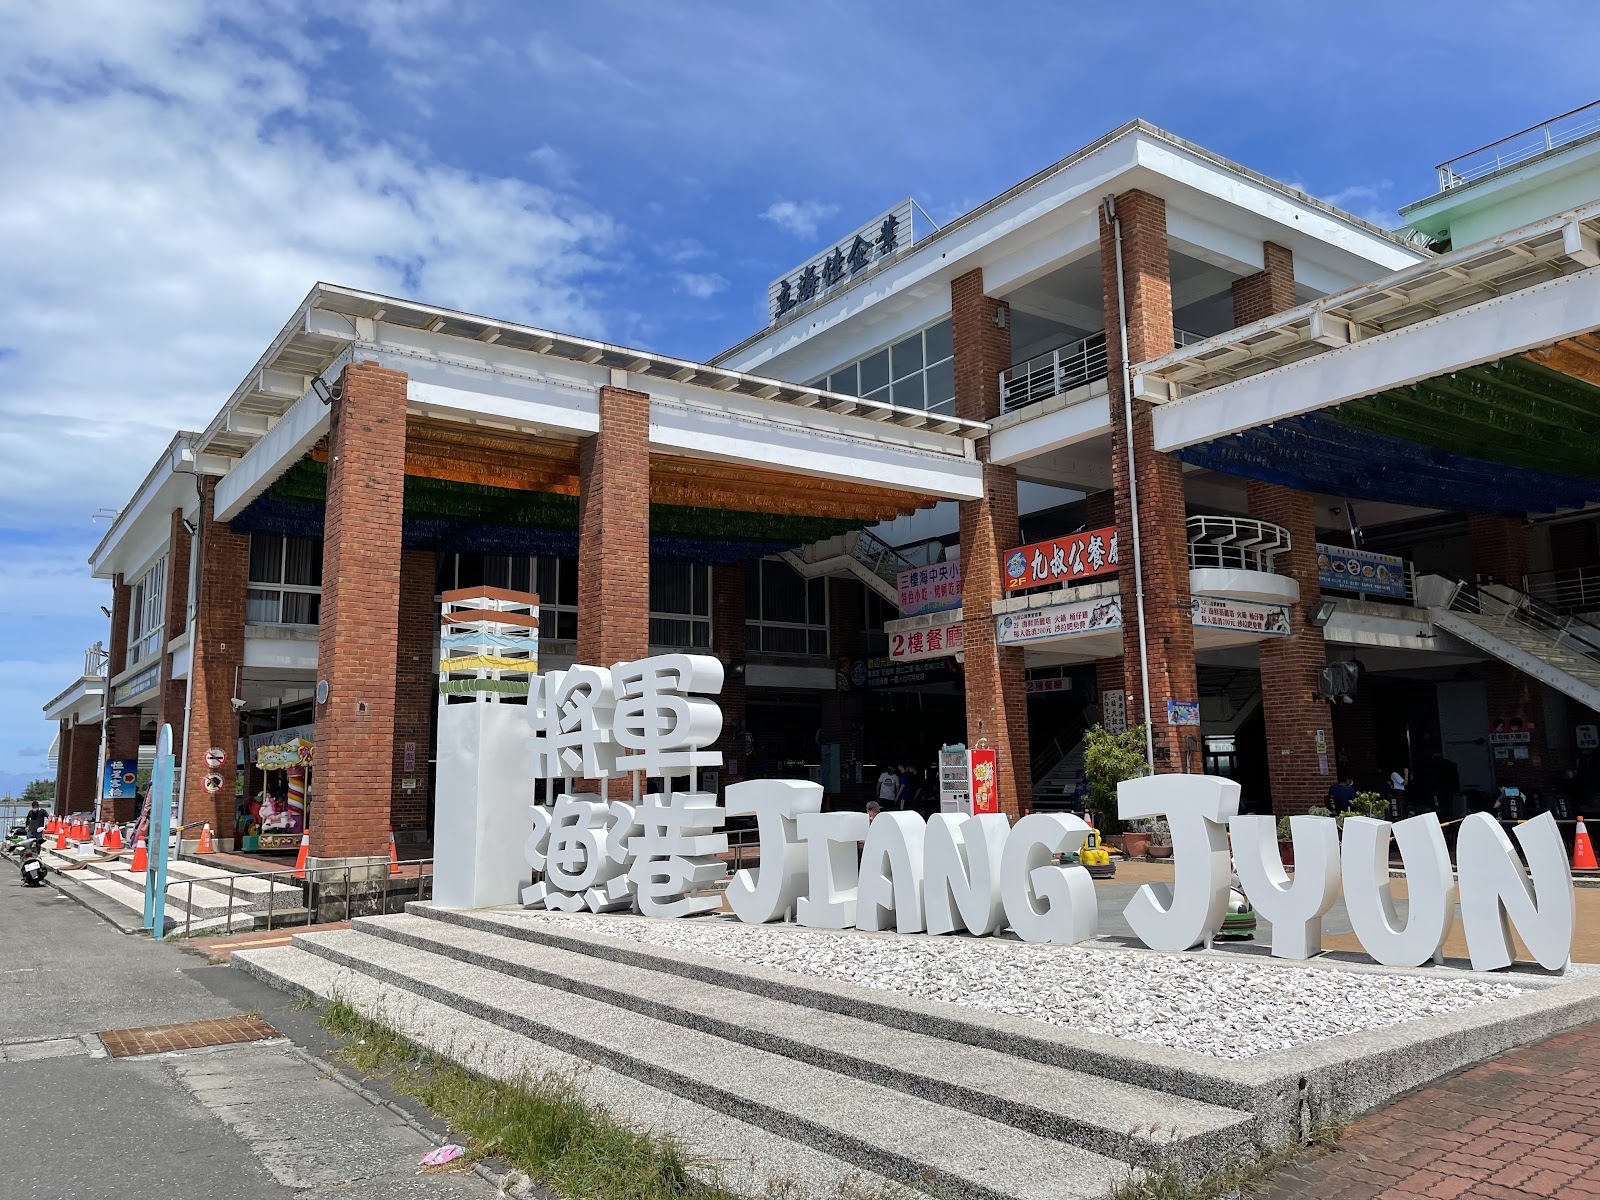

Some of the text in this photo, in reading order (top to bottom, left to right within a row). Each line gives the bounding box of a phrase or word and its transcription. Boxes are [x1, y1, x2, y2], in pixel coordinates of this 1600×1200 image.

[775, 213, 899, 318] 立海佳企業
[901, 563, 961, 590] 三樓海中央小
[1009, 577, 1027, 588] 2F
[1054, 614, 1067, 623] 火鍋
[1069, 610, 1089, 621] 桶仔雞
[1054, 620, 1086, 633] 沙拉吧免費
[892, 625, 963, 657] 2樓餐廳
[1027, 679, 1063, 692] 2樓餐廳
[527, 653, 724, 779] 將軍
[521, 791, 728, 917] 漁港
[725, 773, 1574, 972] JIANG JYUN
